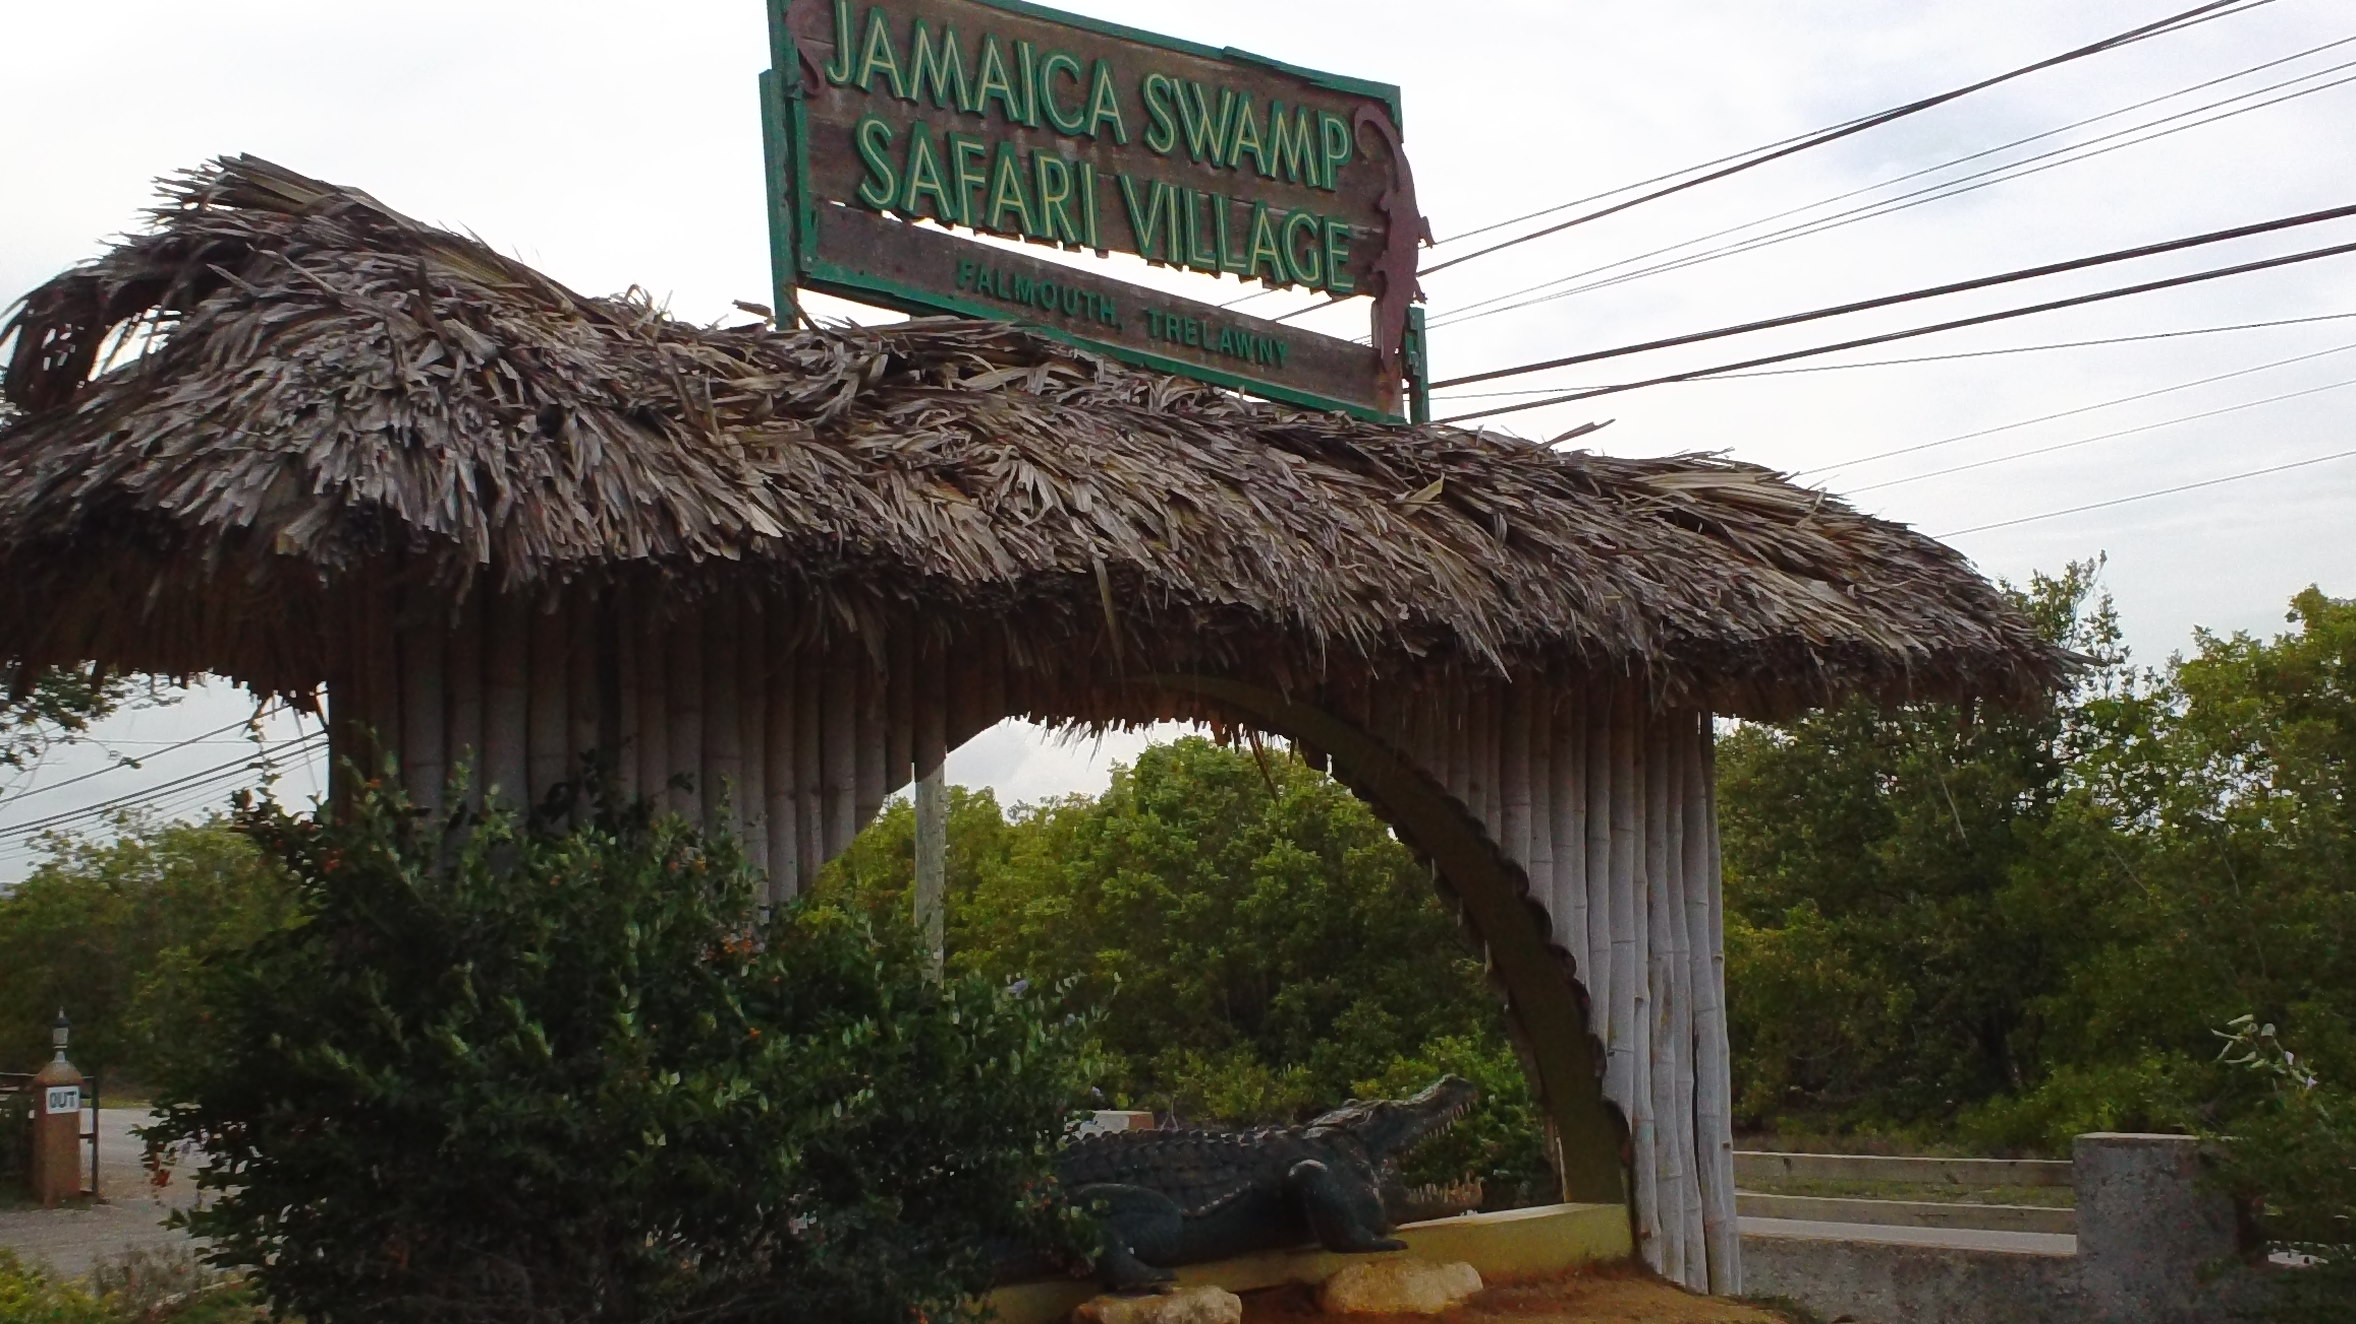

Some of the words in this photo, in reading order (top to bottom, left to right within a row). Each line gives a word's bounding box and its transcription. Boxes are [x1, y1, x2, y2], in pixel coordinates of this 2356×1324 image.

[826, 0, 1128, 145] JAMAICA
[1143, 73, 1352, 191] SWAMP
[856, 112, 1100, 247] SAFARI
[1119, 171, 1354, 294] VILLAGE
[1146, 308, 1288, 368] TRELAWNY
[50, 1091, 77, 1108] OUT
